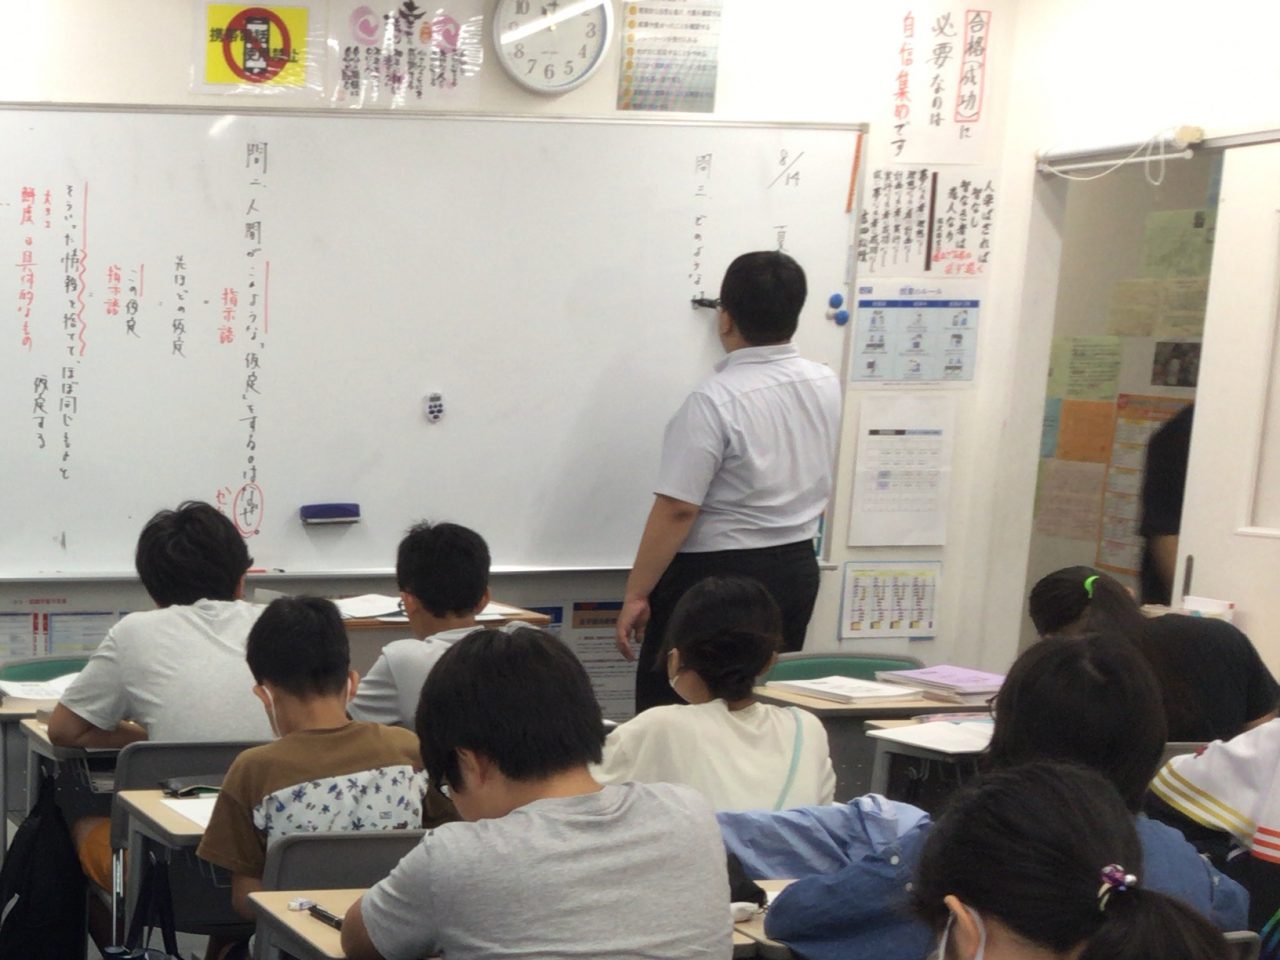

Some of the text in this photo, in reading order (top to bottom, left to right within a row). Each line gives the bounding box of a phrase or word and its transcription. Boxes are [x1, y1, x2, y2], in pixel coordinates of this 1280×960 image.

[585, 22, 597, 38] 3
[513, 43, 525, 58] 8
[578, 44, 587, 59] 4
[526, 59, 537, 75] 7
[544, 64, 555, 79] 6
[564, 60, 574, 75] 5
